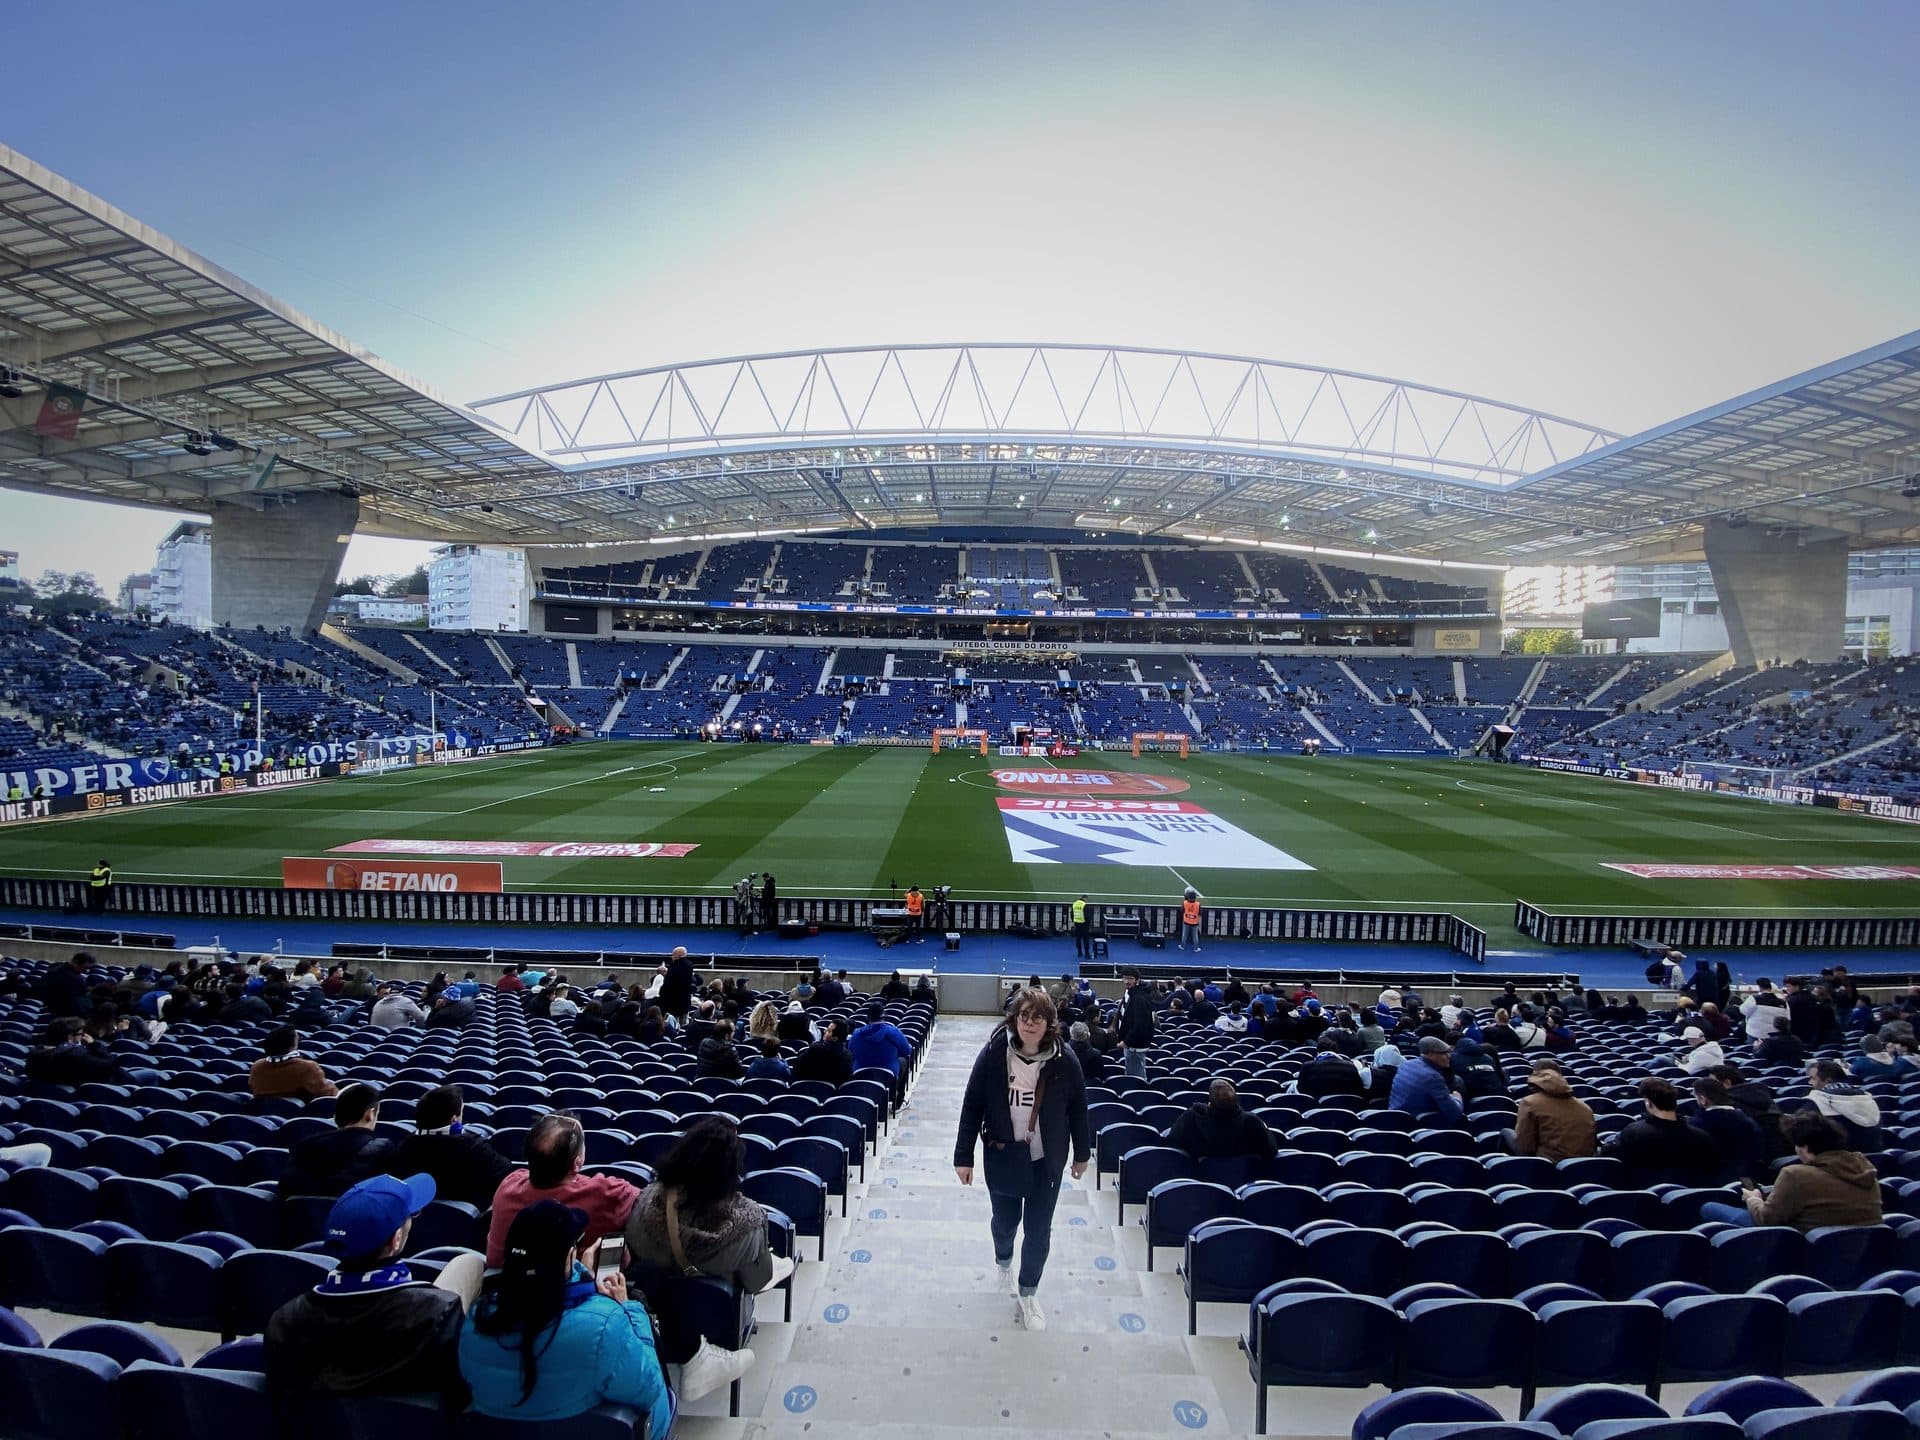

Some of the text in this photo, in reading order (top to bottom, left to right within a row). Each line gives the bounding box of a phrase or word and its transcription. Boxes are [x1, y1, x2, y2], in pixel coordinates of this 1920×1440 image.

[952, 641, 991, 649] FUTEBOL
[477, 744, 497, 755] ATZ
[257, 766, 321, 786] ESCONLINE.PT
[1539, 761, 1565, 770] DARDO
[1603, 768, 1630, 779] ATZ
[998, 771, 1114, 785] BETANO
[130, 780, 214, 804] ESCONLINE.PT
[1016, 799, 1181, 812] Betclic
[1051, 811, 1209, 824] PORTUGAL
[1145, 822, 1228, 833] LIGA
[360, 871, 458, 892] BETANO
[1123, 1317, 1144, 1330] 18
[790, 1390, 813, 1409] 19
[1177, 1407, 1202, 1423] 19
